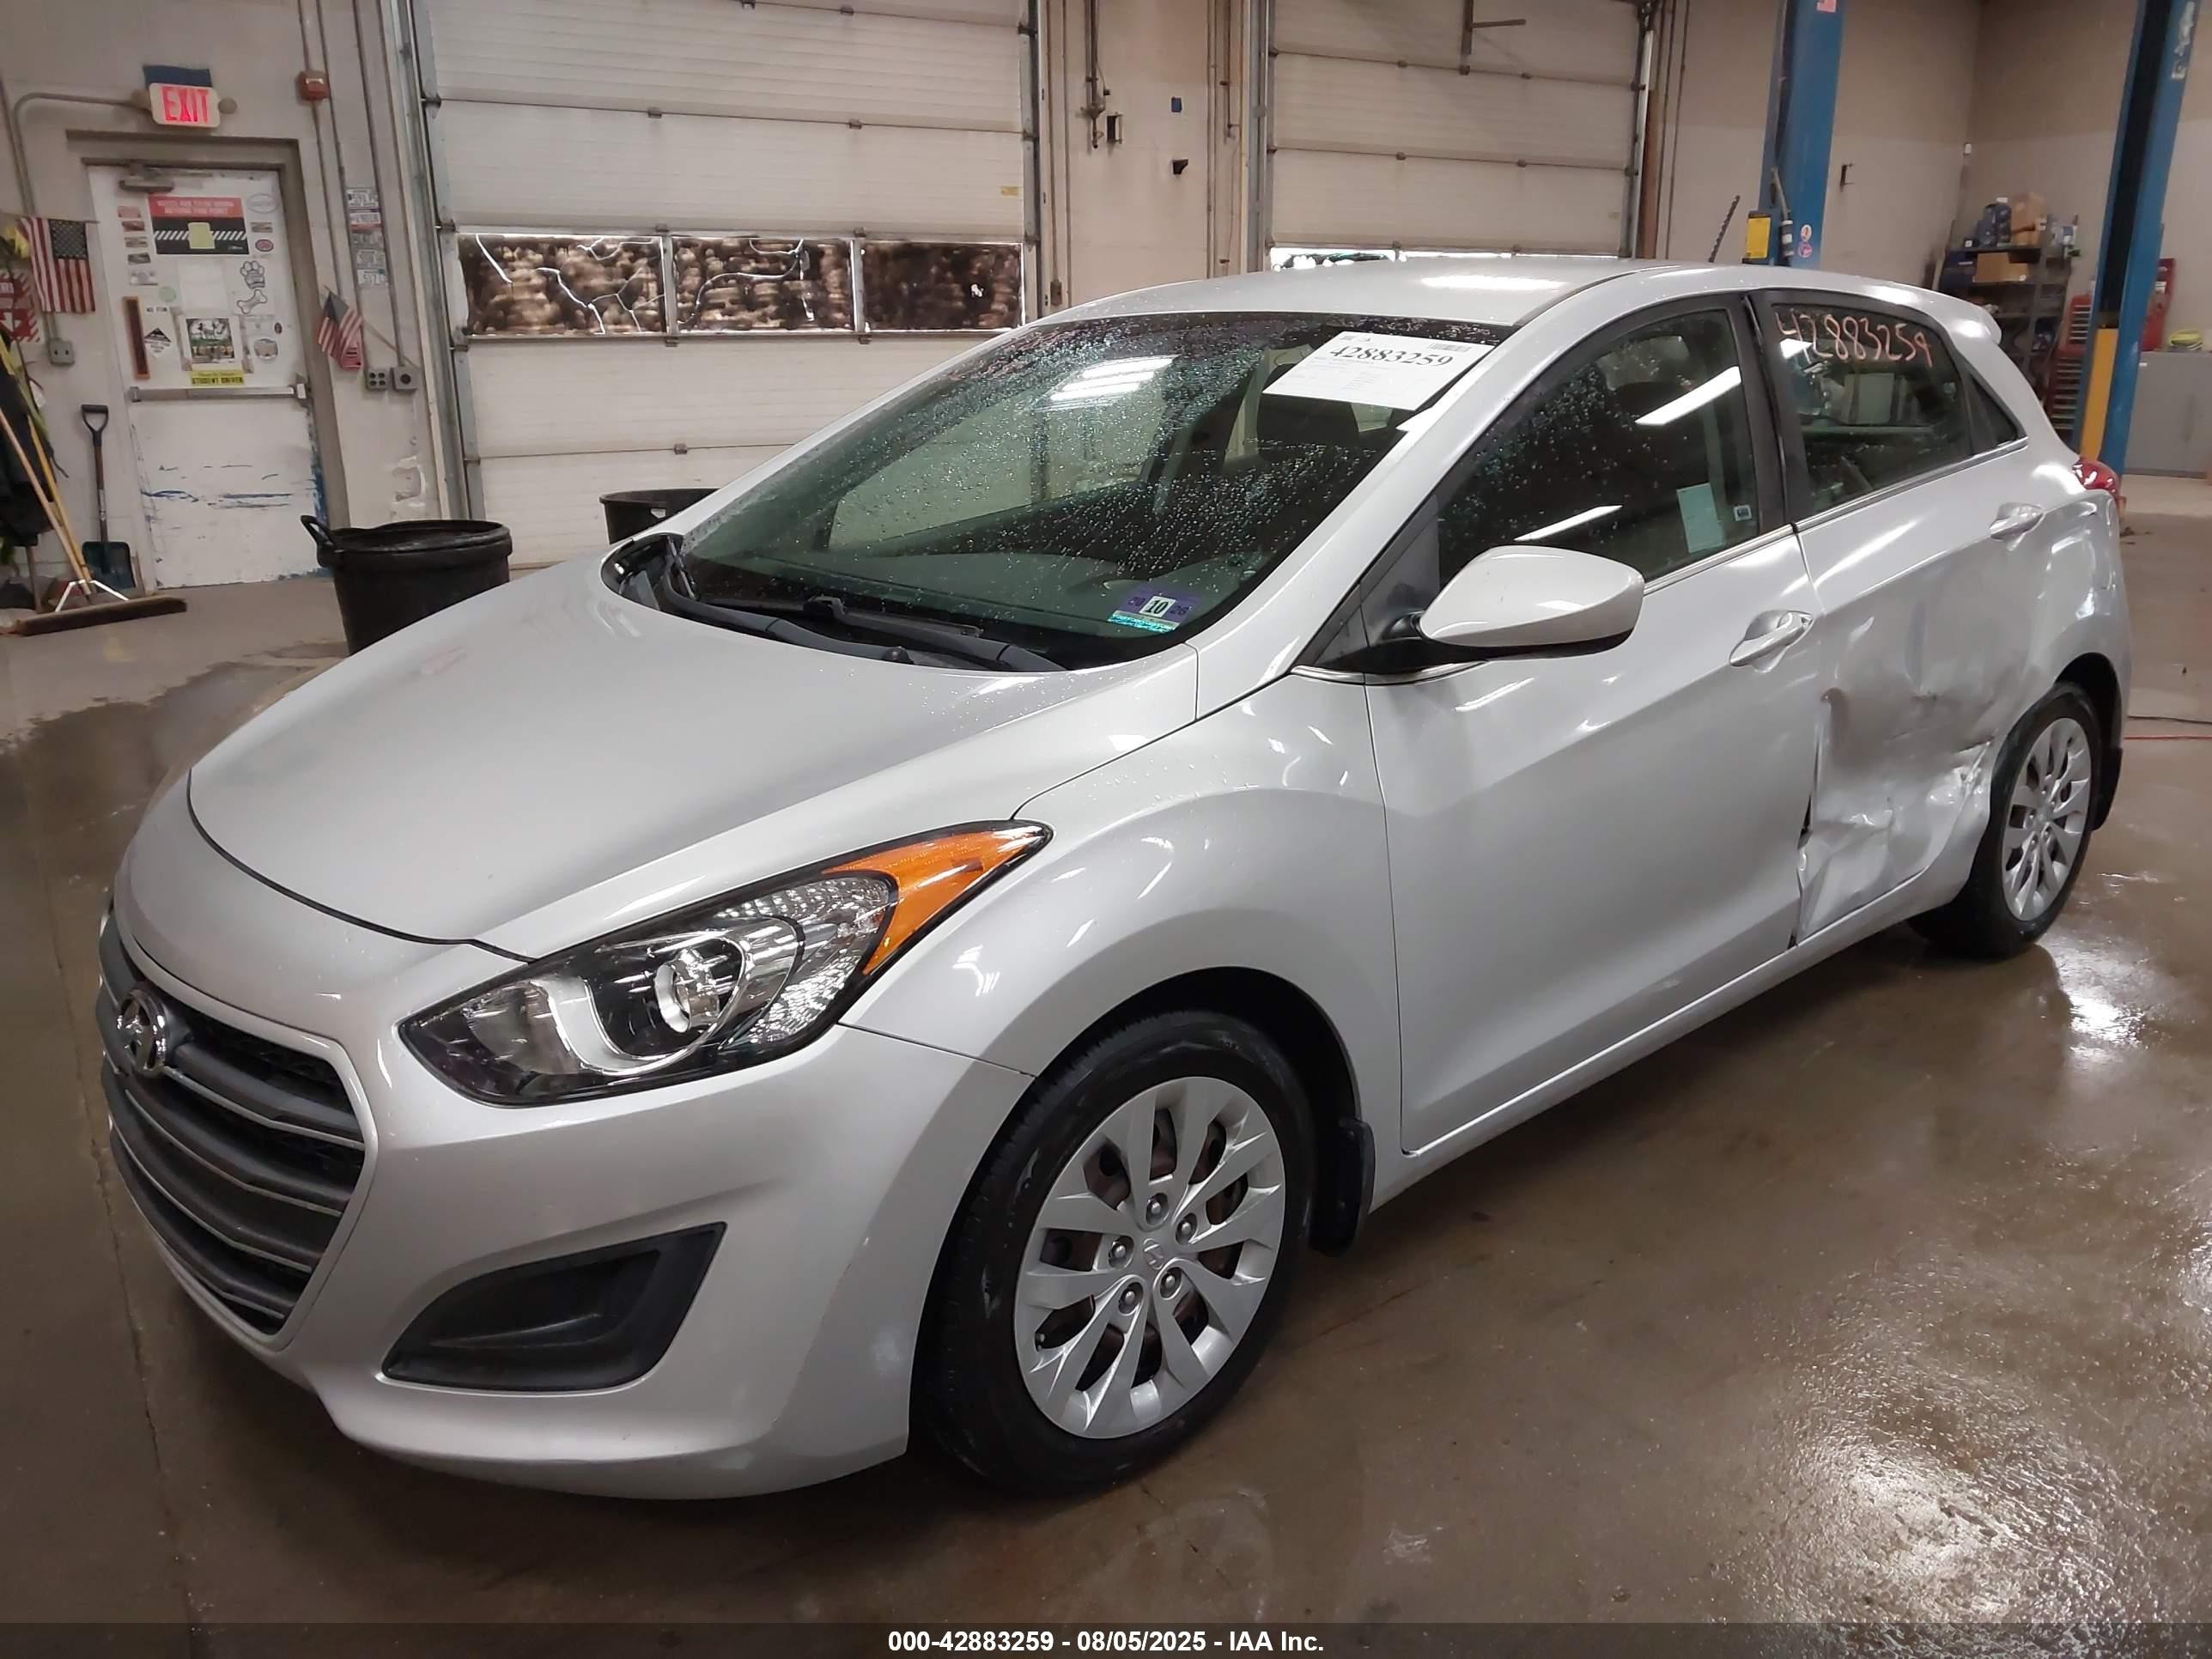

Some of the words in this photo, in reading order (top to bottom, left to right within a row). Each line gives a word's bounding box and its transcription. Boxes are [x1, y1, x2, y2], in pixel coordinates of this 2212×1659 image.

[161, 86, 209, 123] EXIT
[1774, 308, 1933, 368] 42883259
[1330, 345, 1454, 367] 42883259
[1146, 599, 1170, 614] 10
